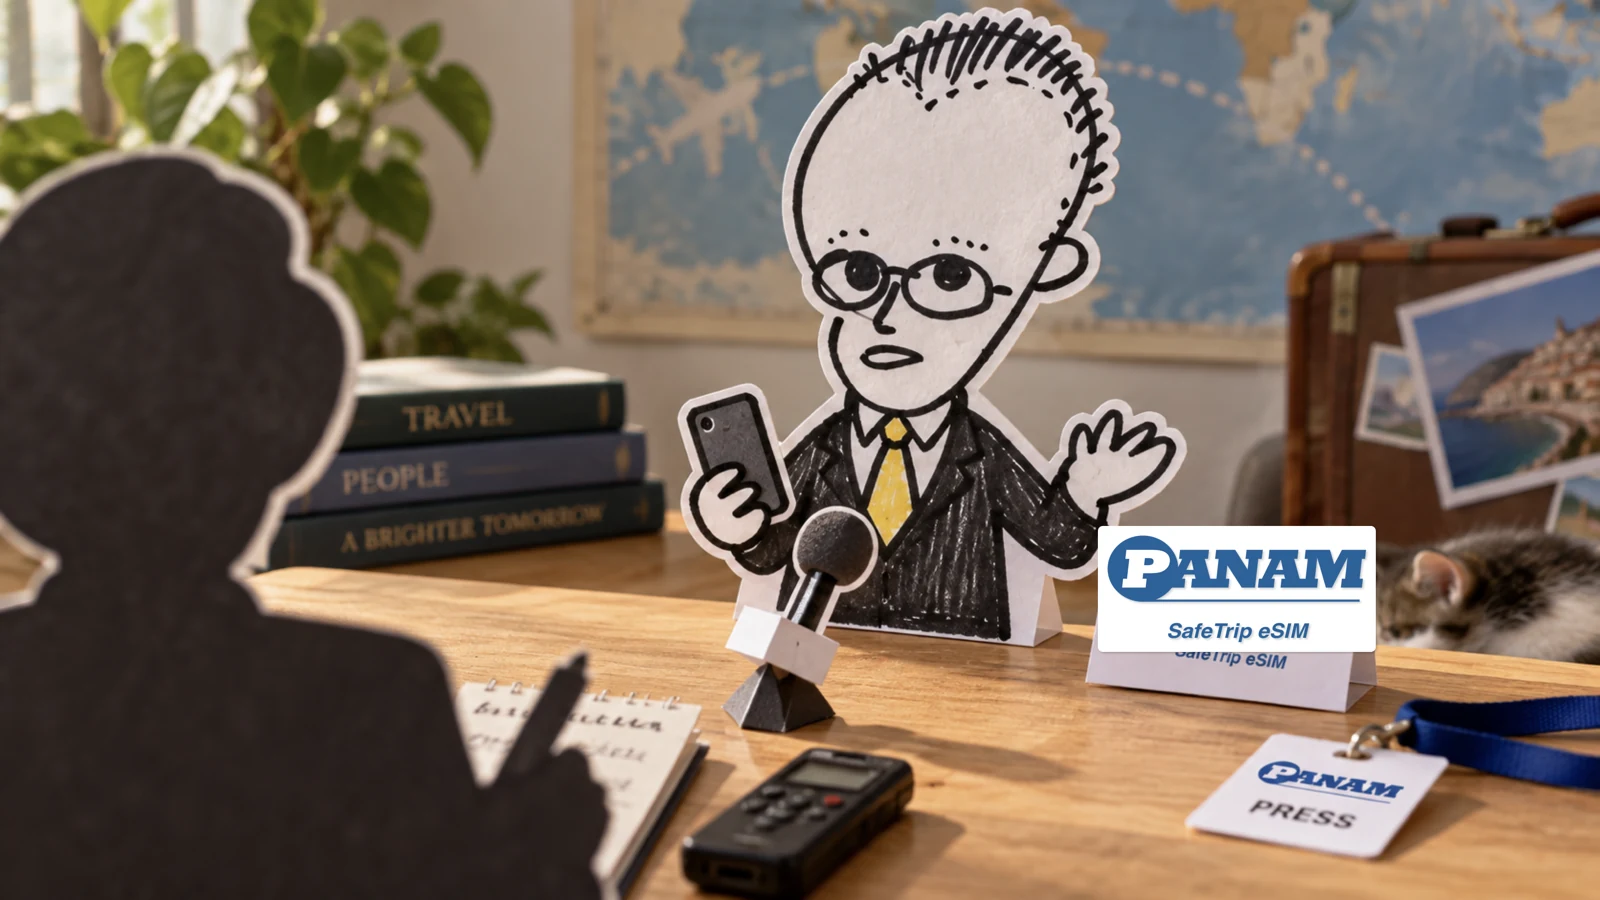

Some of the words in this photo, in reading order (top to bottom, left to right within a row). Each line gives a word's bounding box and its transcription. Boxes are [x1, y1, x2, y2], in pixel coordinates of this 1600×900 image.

[403, 402, 511, 432] TRAVEL
[342, 462, 448, 494] PEOPLE
[341, 532, 359, 552] A
[364, 518, 474, 549] BRIGHTER
[481, 504, 603, 535] TOMORROW
[1245, 653, 1288, 669] eSIM
[1258, 762, 1404, 799] PANAM
[1249, 800, 1357, 830] PRESS
